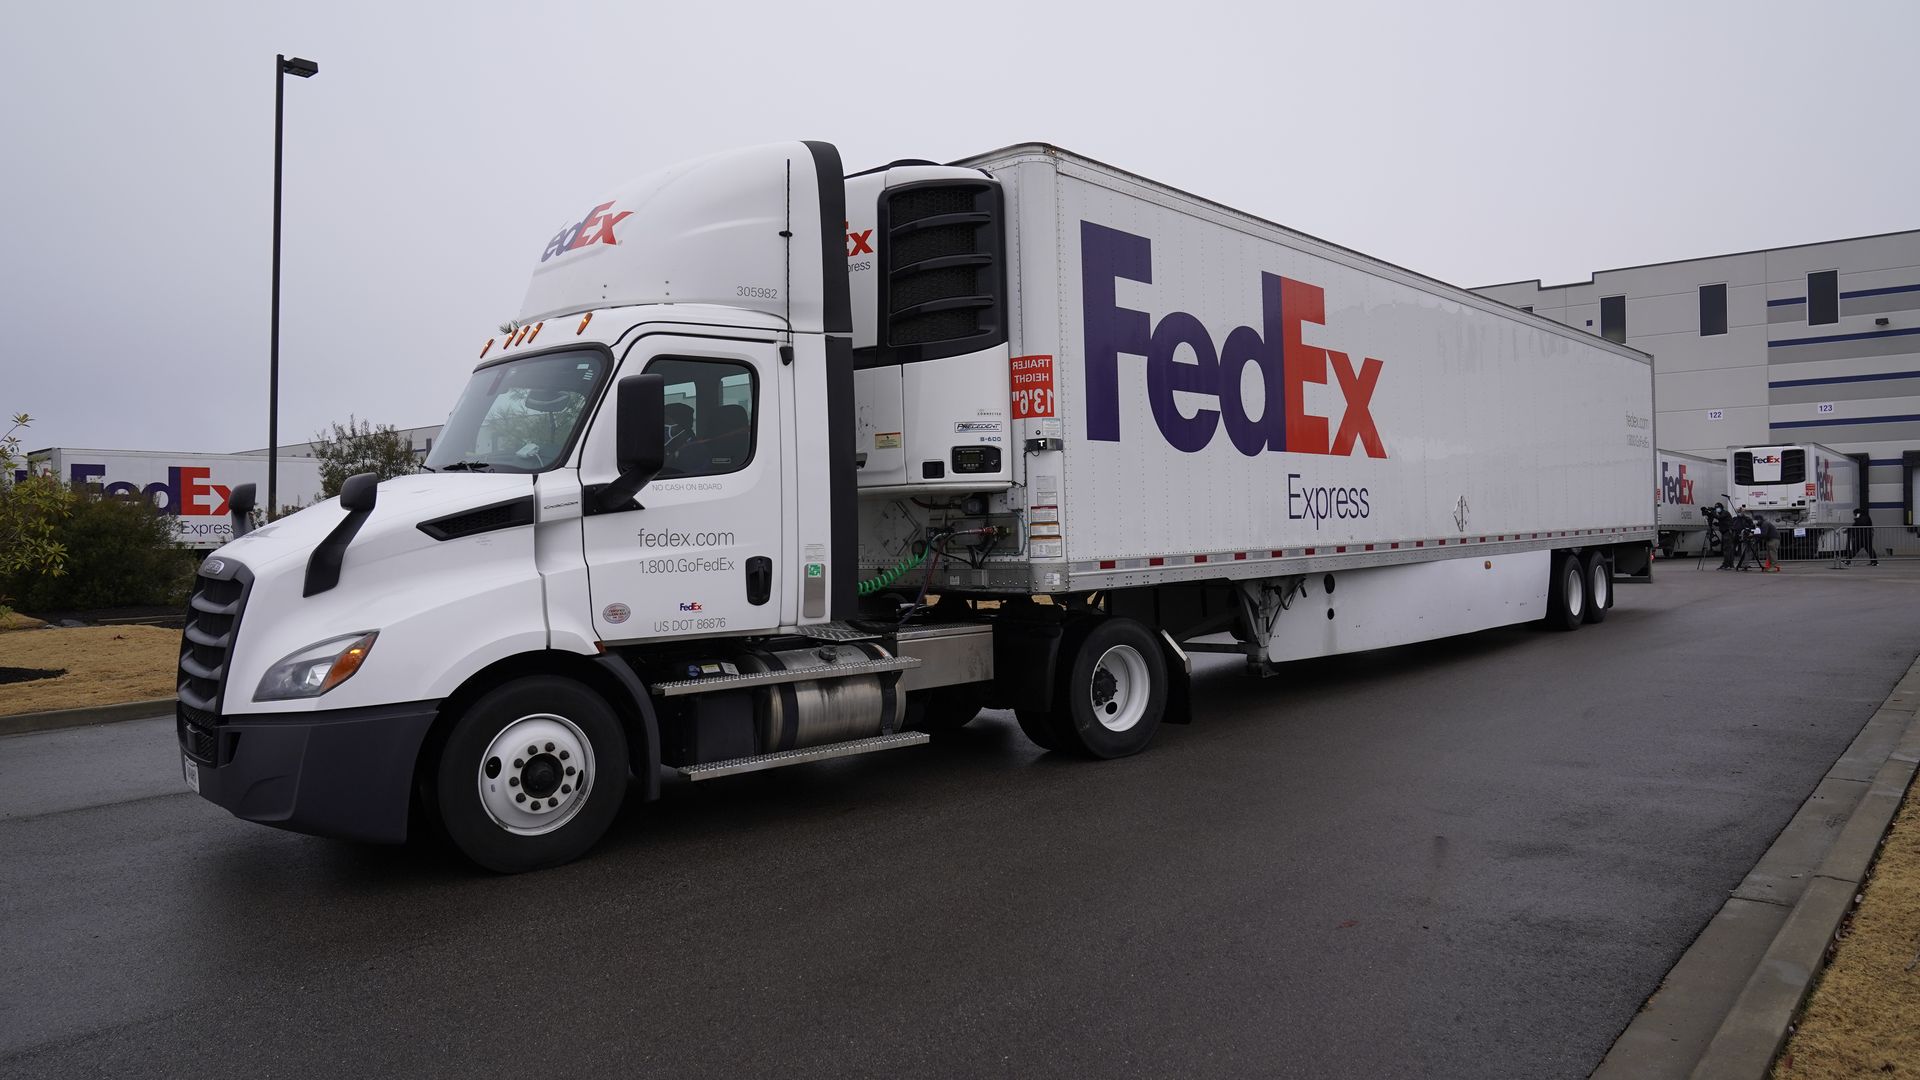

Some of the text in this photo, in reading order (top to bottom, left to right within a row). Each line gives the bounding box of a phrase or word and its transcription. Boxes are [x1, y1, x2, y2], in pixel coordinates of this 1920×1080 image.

[541, 200, 634, 262] edEx
[847, 261, 871, 272] press
[736, 286, 778, 299] 305982
[1080, 219, 1388, 459] FedEx
[1709, 410, 1722, 419] 122
[1818, 404, 1833, 412] 123
[1753, 456, 1780, 464] FedEx
[665, 483, 685, 491] CASH
[698, 482, 722, 490] BOARD
[1661, 461, 1694, 505] FedEx
[1288, 473, 1370, 530] Express
[637, 528, 735, 547] fedex.com
[639, 557, 735, 574] 1.800.GoFedEx
[680, 602, 702, 611] FedEx
[654, 618, 726, 632] US DOT 86876
